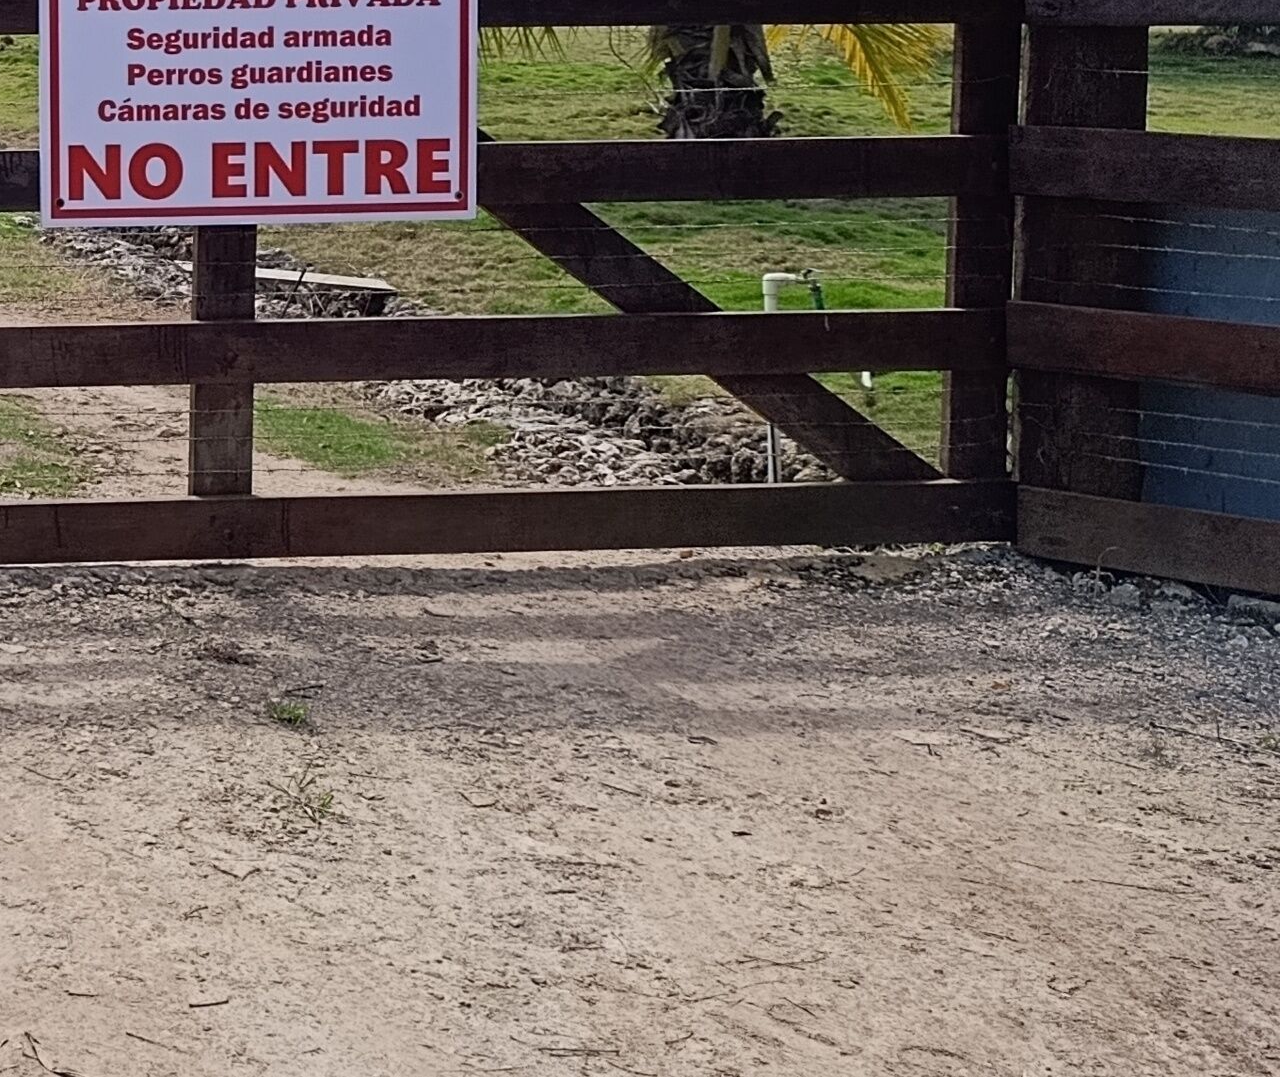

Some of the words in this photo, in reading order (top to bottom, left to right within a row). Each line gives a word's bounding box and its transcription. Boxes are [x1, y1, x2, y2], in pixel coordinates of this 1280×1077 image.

[126, 26, 275, 55] Seguridad
[283, 24, 392, 48] armada
[127, 63, 224, 86] Perros
[230, 60, 393, 89] guardianes
[97, 97, 226, 122] Cámaras
[234, 98, 271, 121] de
[278, 95, 421, 123] seguridad
[67, 142, 184, 202] NO
[211, 138, 452, 199] ENTRE
